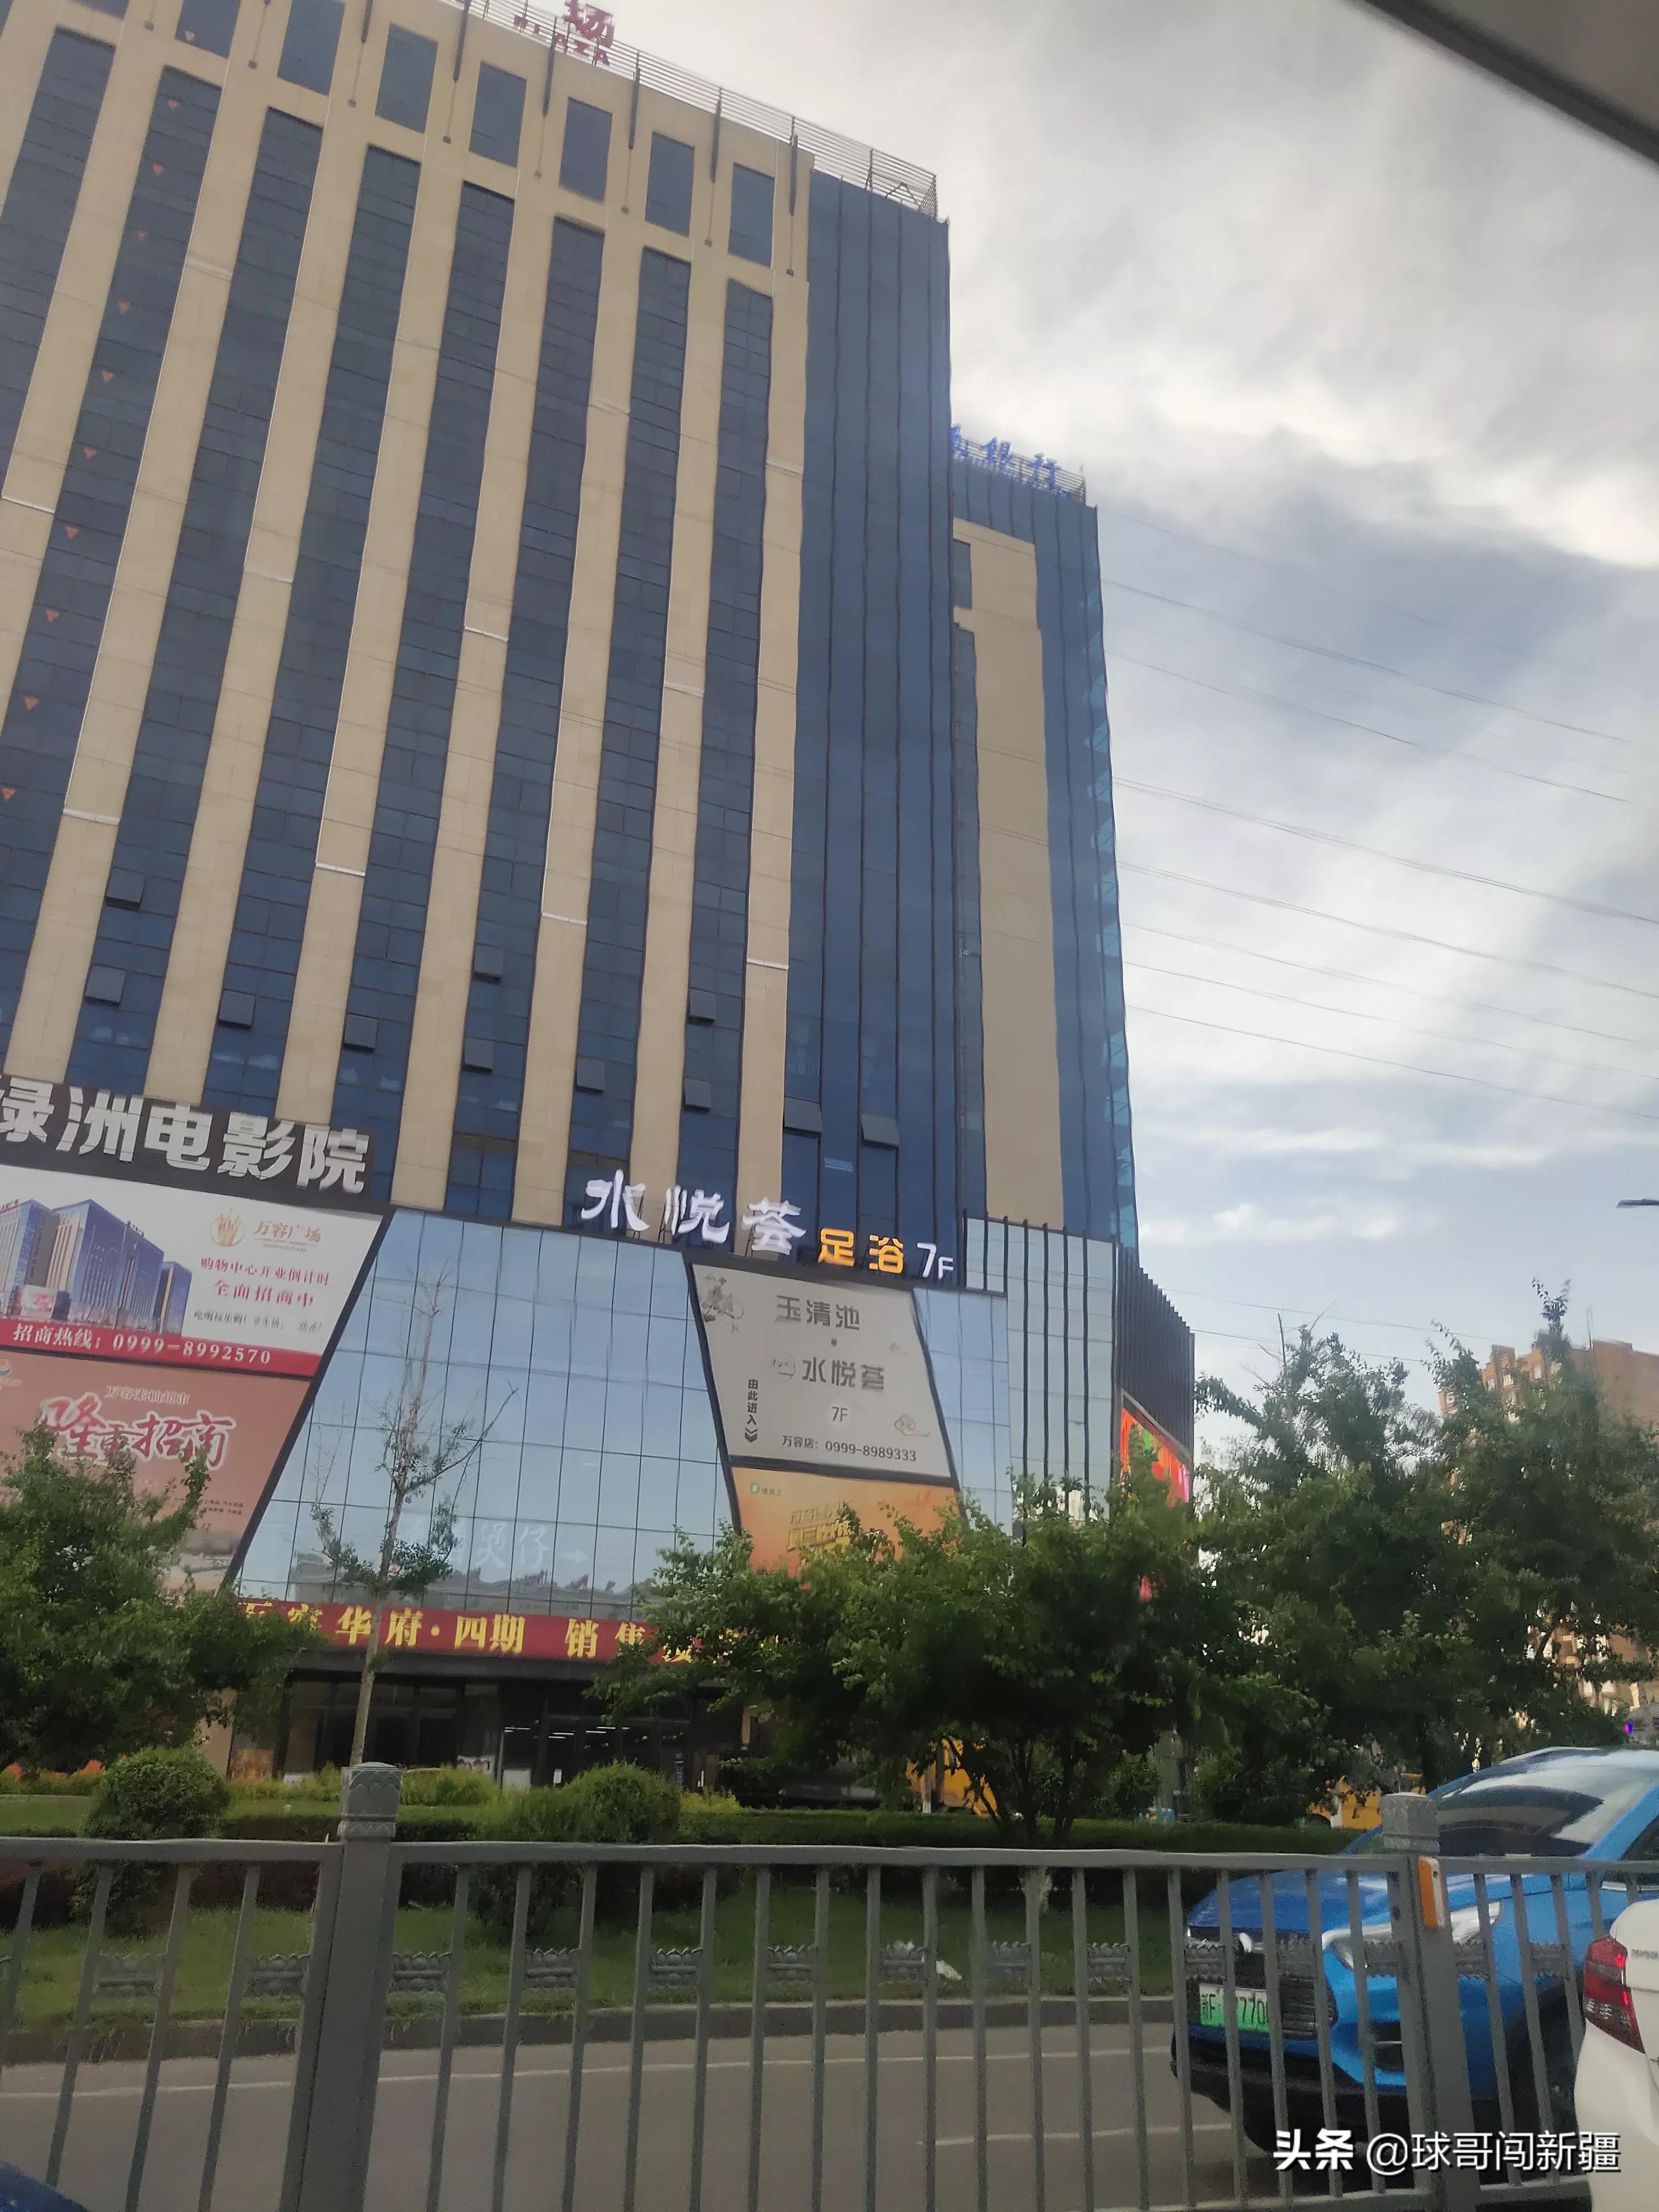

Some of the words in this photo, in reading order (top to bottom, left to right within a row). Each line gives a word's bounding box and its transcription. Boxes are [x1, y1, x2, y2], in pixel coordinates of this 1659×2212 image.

[581, 1169, 806, 1255] 水悦荟
[253, 1220, 321, 1243] 万容广场
[817, 1228, 904, 1274] 足浴
[917, 1242, 954, 1280] 7F
[201, 1257, 330, 1286] 购物中心开业倒计时
[213, 1279, 314, 1307] 全面招商中
[776, 1295, 860, 1331] 玉清池
[112, 1334, 272, 1364] 0999-8992570
[802, 1357, 885, 1392] 水悦荟
[747, 1379, 758, 1425] 由此进入
[831, 1407, 848, 1422] 7F
[825, 1441, 917, 1462] 0999-8989333
